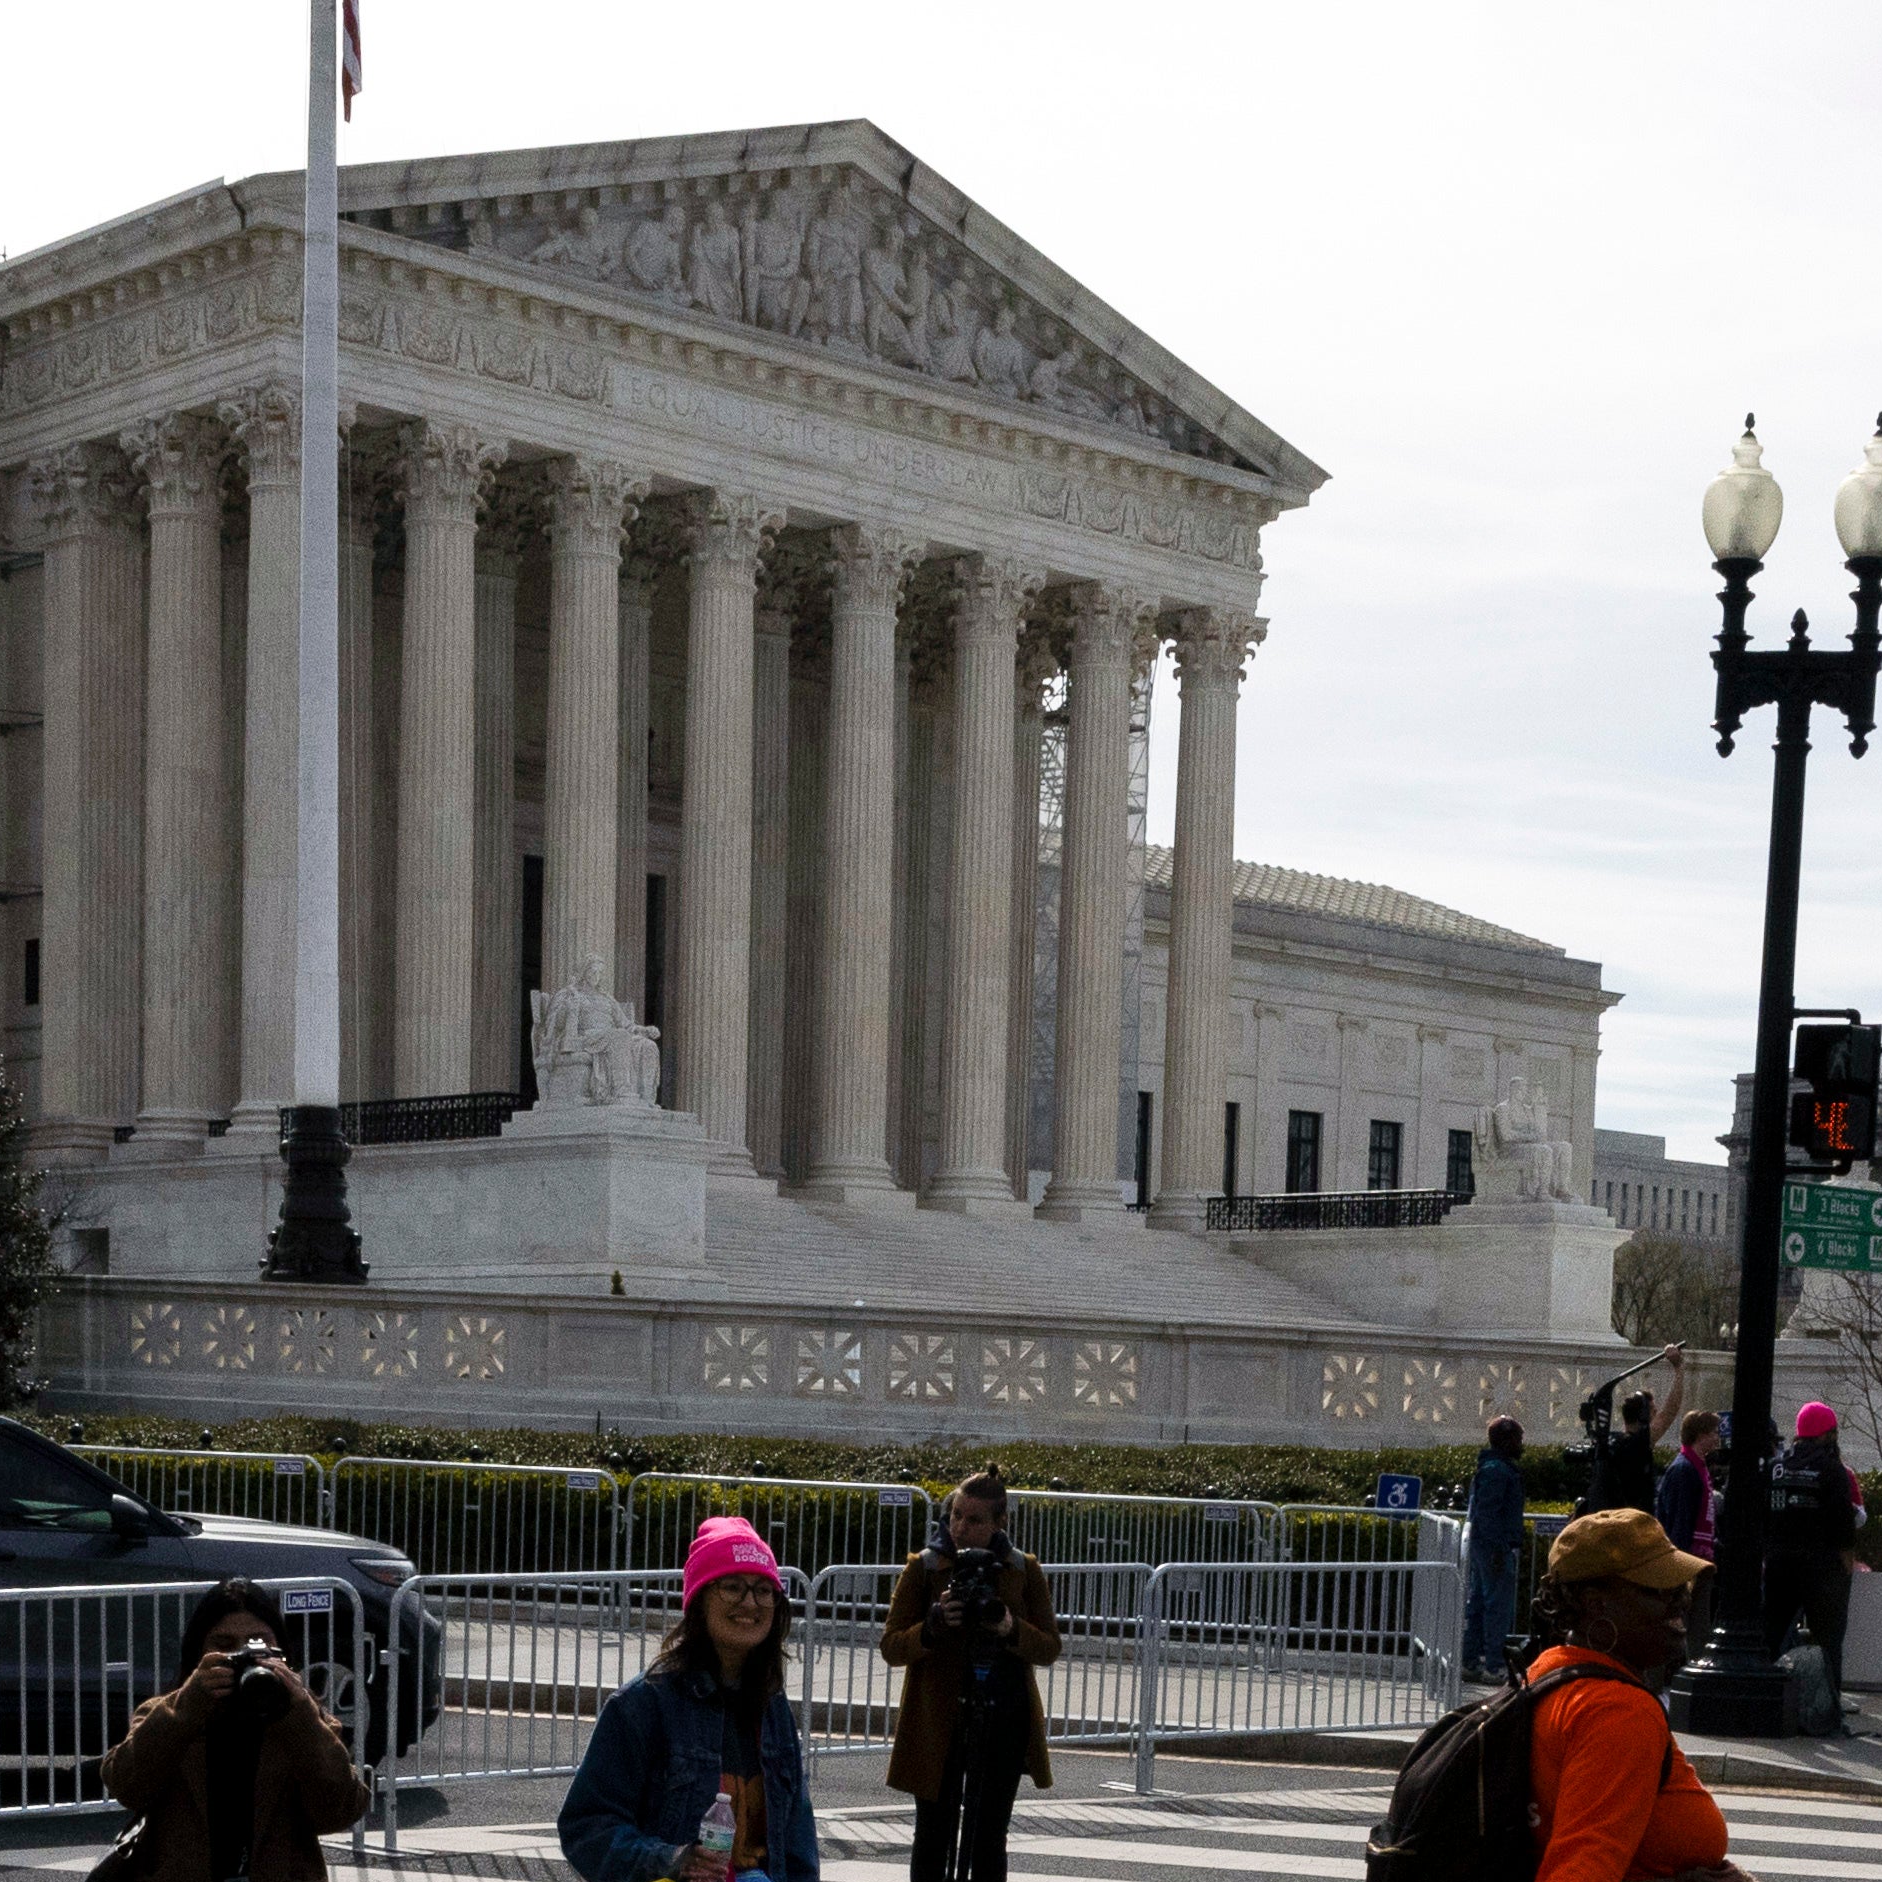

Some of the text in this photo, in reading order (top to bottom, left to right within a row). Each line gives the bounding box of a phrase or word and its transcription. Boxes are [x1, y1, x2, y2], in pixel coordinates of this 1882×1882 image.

[737, 406, 842, 457] JUSTICE
[855, 436, 940, 478] UNDER
[949, 461, 998, 494] LAW
[1820, 1197, 1860, 1216] 3 Blocks
[1817, 1239, 1858, 1257] 6 Blocks
[287, 1593, 330, 1608] LONG FENCE
